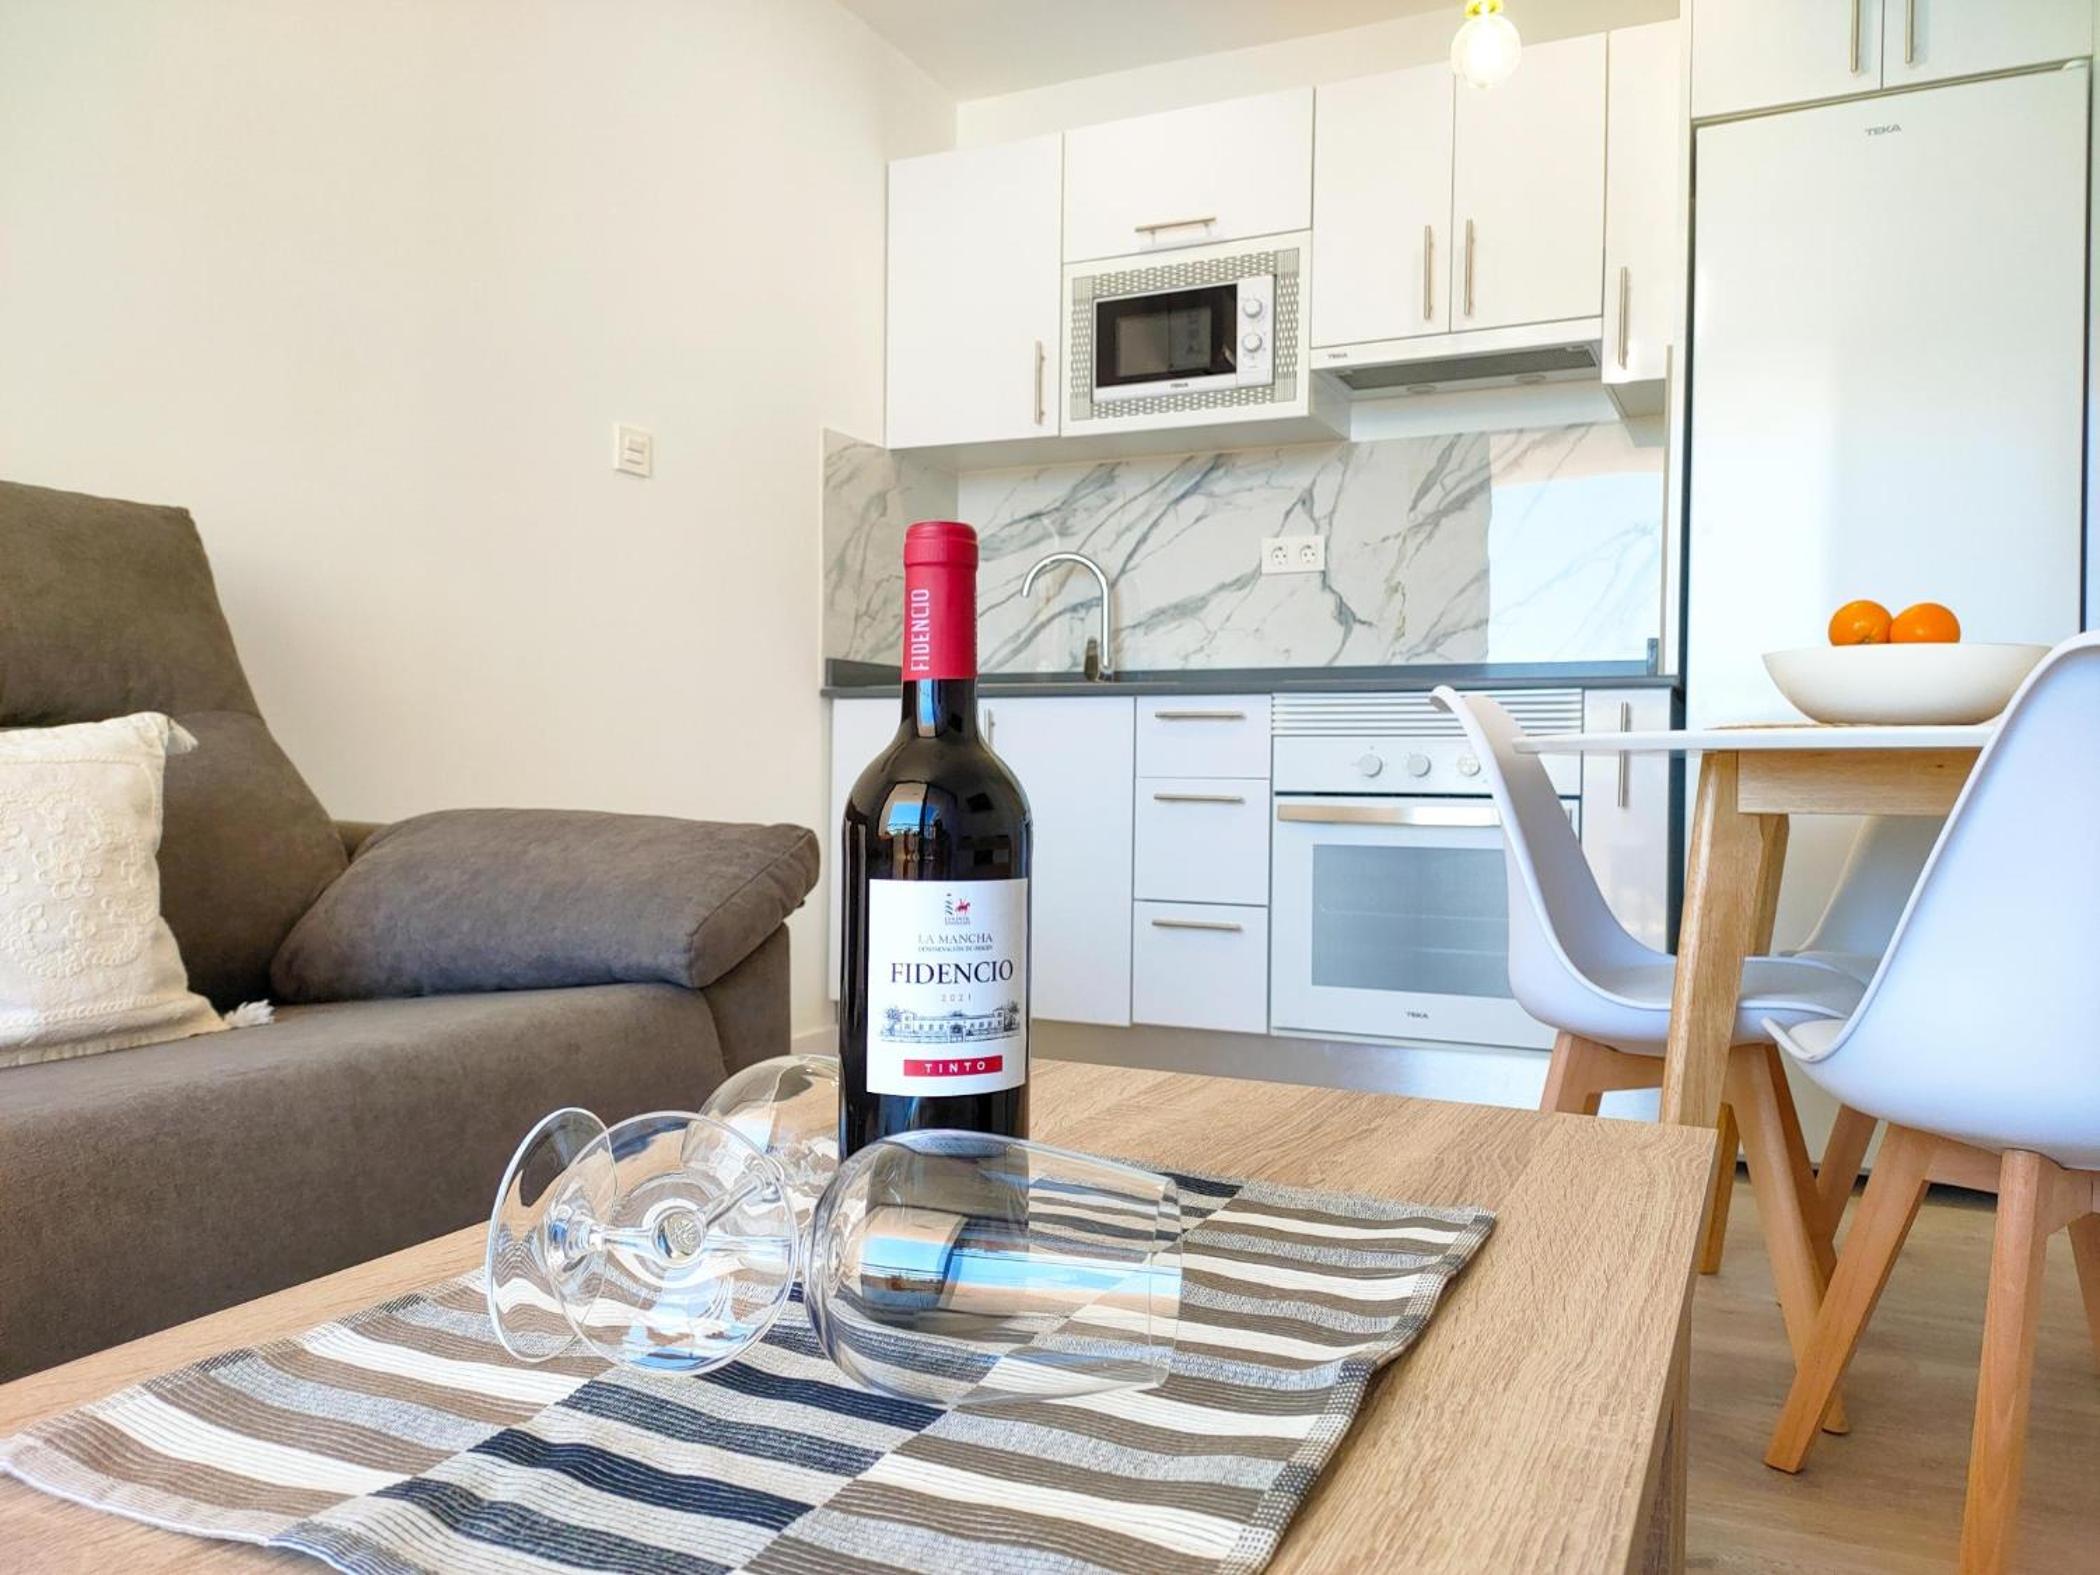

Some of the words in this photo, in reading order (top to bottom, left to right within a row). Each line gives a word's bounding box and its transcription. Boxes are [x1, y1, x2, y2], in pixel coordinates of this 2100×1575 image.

[1864, 124, 1902, 136] TEKA
[910, 588, 931, 671] FIDENCIO
[917, 933, 935, 944] LA
[939, 932, 993, 944] MANCHA
[891, 959, 1014, 985] FIDENCIO
[941, 992, 971, 1002] 2021
[925, 1060, 986, 1073] TINTO
